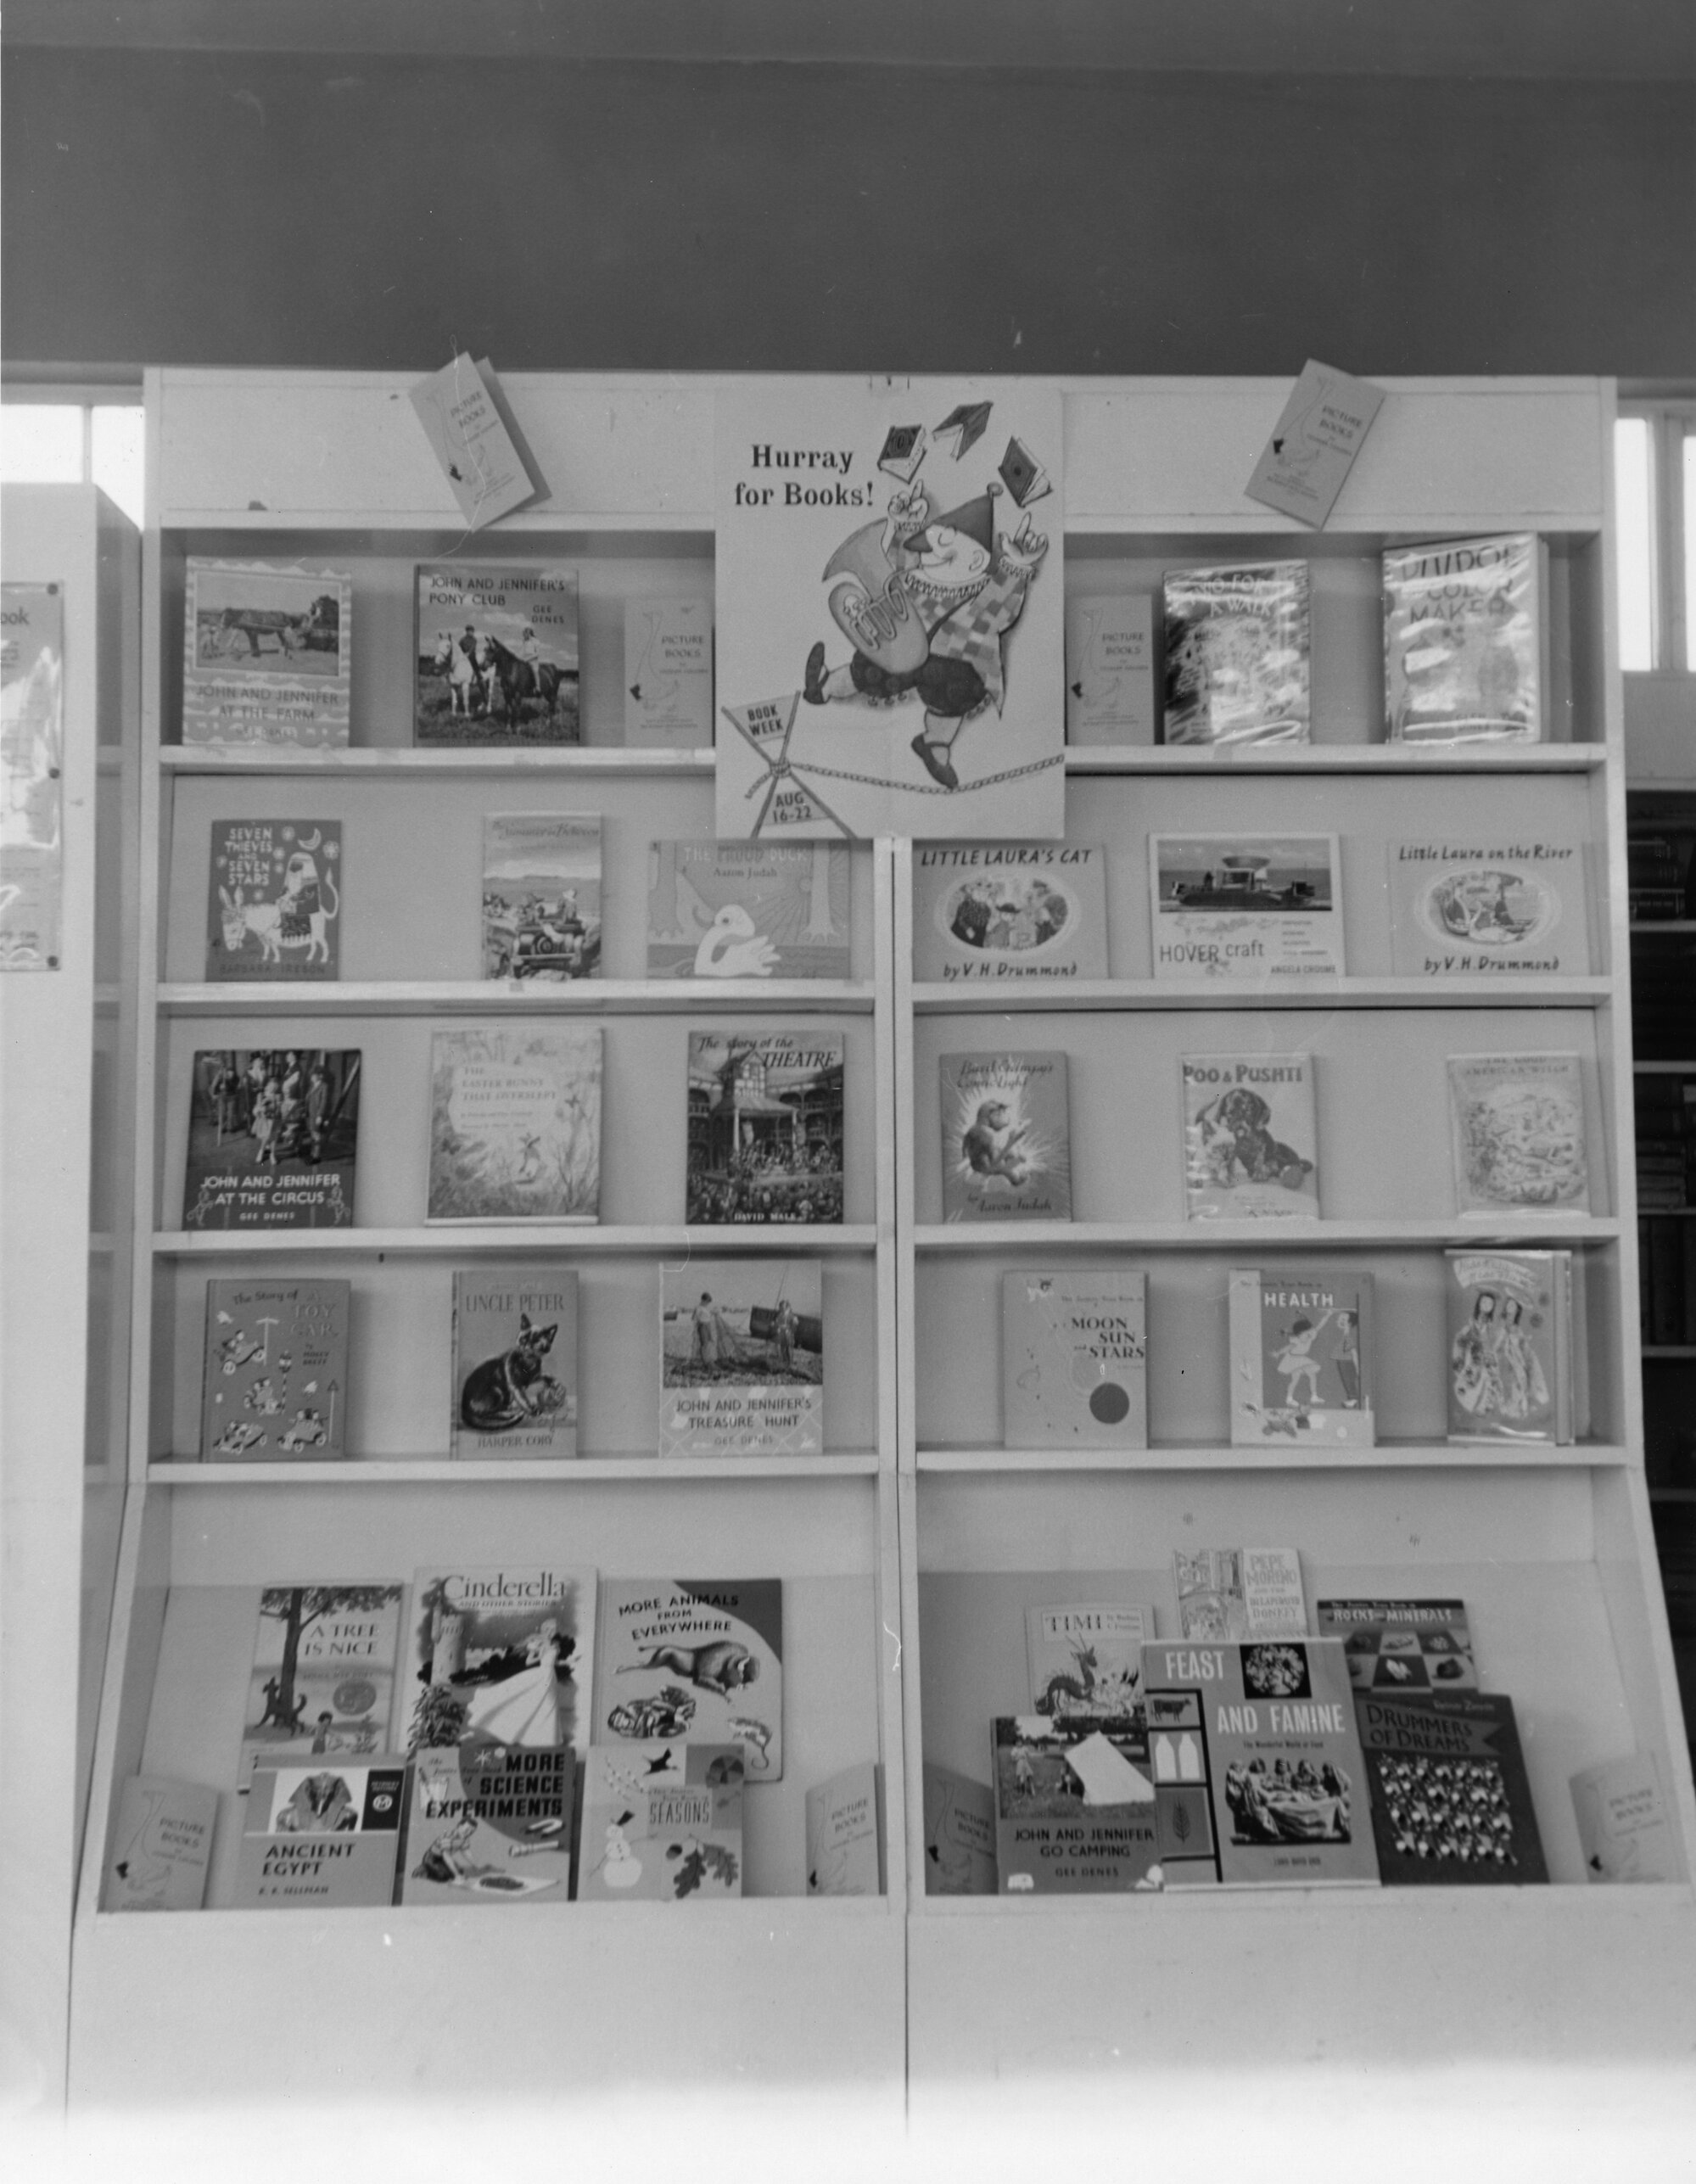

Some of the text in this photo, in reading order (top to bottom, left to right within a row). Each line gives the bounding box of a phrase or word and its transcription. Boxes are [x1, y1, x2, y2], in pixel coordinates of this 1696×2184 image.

[751, 444, 854, 474] Hurray
[735, 481, 874, 506] for Books!
[430, 576, 565, 591] JOHN AND JENNIFER'S
[429, 593, 507, 606] PONY CLUB
[532, 605, 551, 613] GEE
[531, 615, 565, 624] DENES
[664, 649, 701, 658] BOOKS
[196, 686, 339, 705] JOHN AND JENNIFER
[219, 705, 316, 720] AT THE FARM
[747, 703, 778, 721] BOOK
[748, 719, 784, 736] WEEK
[773, 807, 812, 823] 16-22
[229, 827, 273, 840] SEVEN
[224, 841, 272, 854] THIEVES
[1400, 844, 1573, 861] Little Laura on the River
[921, 848, 1092, 865] LITTLE LAURA'S CAT
[228, 860, 271, 873] SEVEN
[747, 867, 777, 880] Judah
[228, 873, 271, 886] STARS
[1159, 938, 1264, 963] HOVER craft
[943, 964, 960, 982] by
[1425, 957, 1441, 975] by
[698, 1036, 719, 1052] The
[759, 1037, 772, 1049] of
[775, 1037, 794, 1049] the
[763, 1051, 837, 1067] THEATRE
[200, 1173, 341, 1188] JOHN AND JENNIFER
[214, 1191, 325, 1206] AT THE CIRCUS
[239, 1212, 296, 1222] GEE DENES
[734, 1212, 765, 1222] DAVID
[255, 1291, 284, 1303] Story
[287, 1288, 299, 1302] of
[466, 1293, 565, 1312] UNCLE PETER
[1264, 1291, 1334, 1308] HEALTH
[1071, 1317, 1128, 1330] MOON
[1098, 1331, 1135, 1344] SUN
[1089, 1346, 1145, 1358] STARS
[676, 1397, 812, 1413] JOHN AND JENNIFER'S
[688, 1414, 800, 1430] TREASURE HUNT
[478, 1436, 523, 1449] HARPER
[442, 1571, 565, 1601] Cinderella
[618, 1594, 739, 1617] MORE ANIMALS
[657, 1609, 692, 1621] FROM
[1333, 1609, 1374, 1622] ROCKS
[1386, 1609, 1452, 1622] MINERALS
[310, 1623, 379, 1638] A TREE
[631, 1620, 732, 1641] EVERYWHERE
[305, 1641, 378, 1655] IS NICE
[1165, 1650, 1224, 1680] FEAST
[1217, 1704, 1346, 1733] AND FAMINE
[1366, 1704, 1473, 1738] DRUMMERS
[1369, 1728, 1470, 1753] OF DREAMS
[506, 1753, 565, 1772] MORE
[479, 1774, 564, 1795] SCIENCE
[426, 1798, 563, 1819] EXPERIMENTS
[649, 1800, 710, 1824] SEASONS
[1015, 1828, 1155, 1841] JOHN AND JENNIFER
[265, 1843, 356, 1859] ANCIENT
[1040, 1845, 1131, 1857] GO CAMPING
[261, 1861, 322, 1876] EGYPT
[1055, 1868, 1119, 1877] GEE DENES
